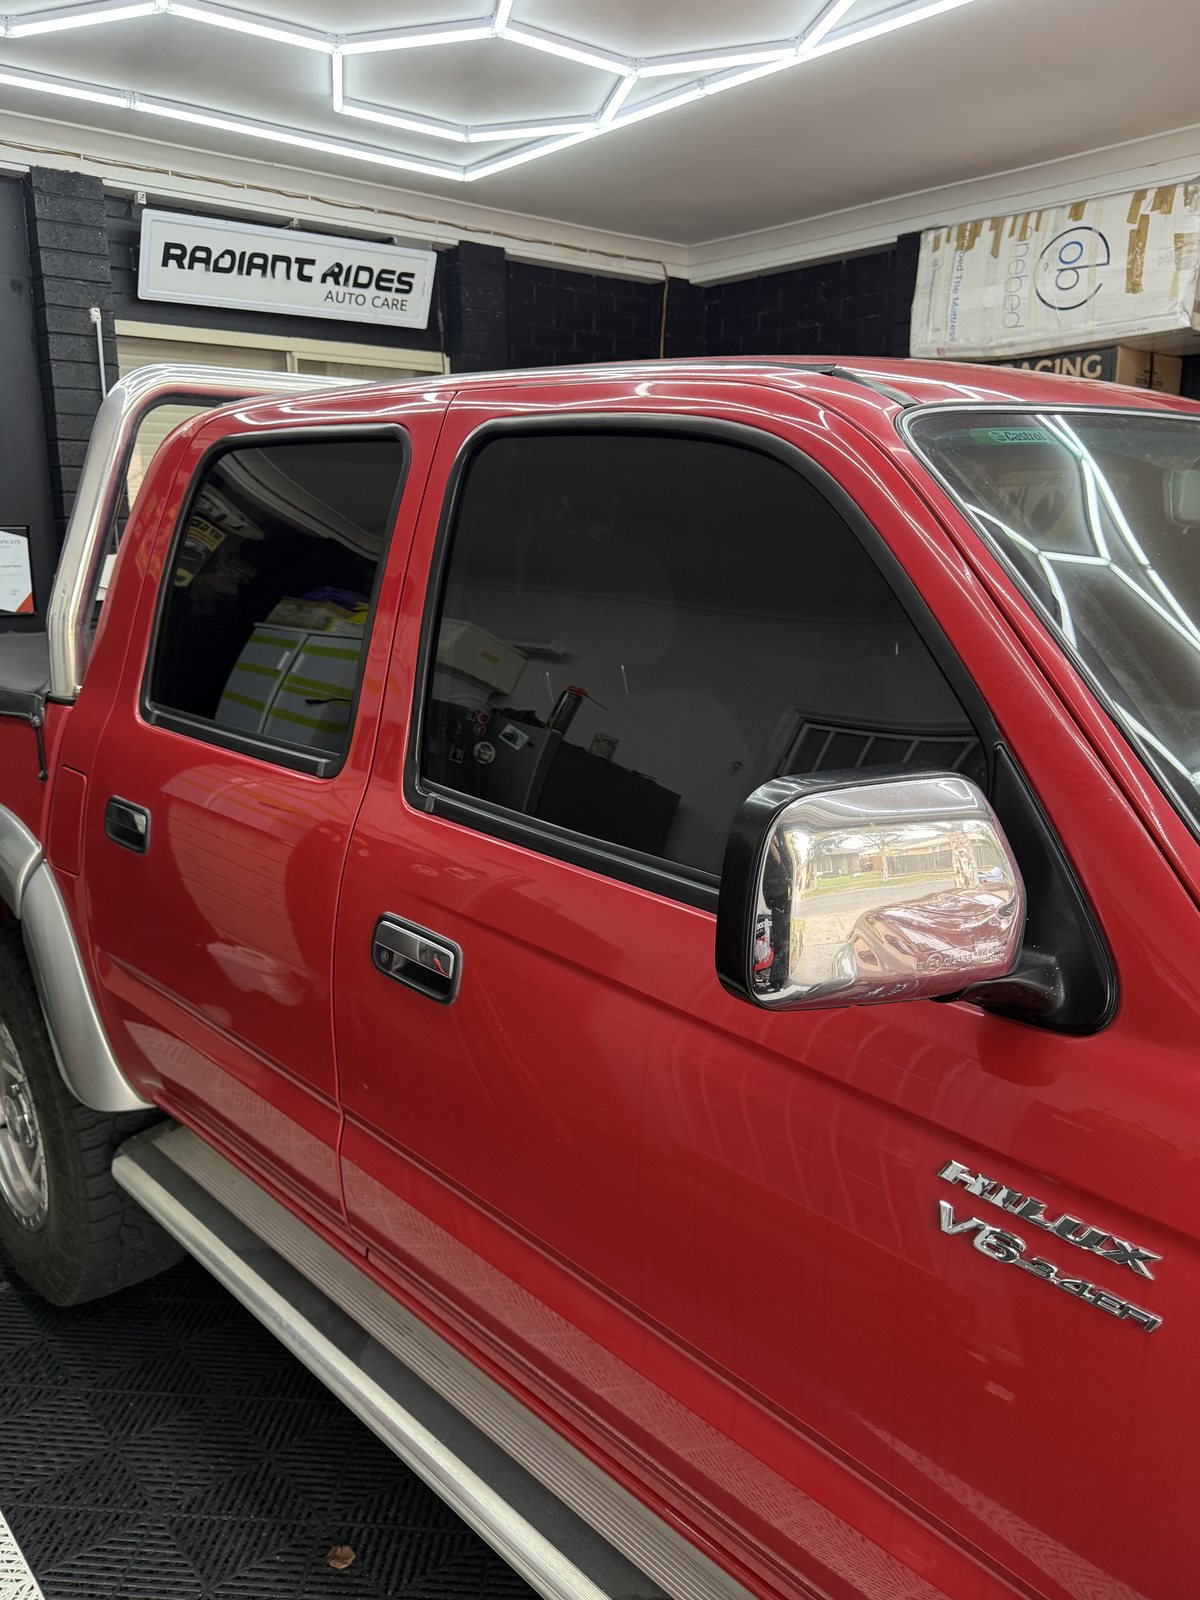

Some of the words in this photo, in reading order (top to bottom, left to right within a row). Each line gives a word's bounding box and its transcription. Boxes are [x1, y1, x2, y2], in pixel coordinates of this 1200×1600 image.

[161, 241, 316, 283] RADIANT
[320, 262, 415, 295] RIDES
[324, 290, 366, 306] AUTO
[371, 296, 409, 312] CARE
[938, 1160, 1163, 1280] HILUX
[940, 1200, 1028, 1264] V6
